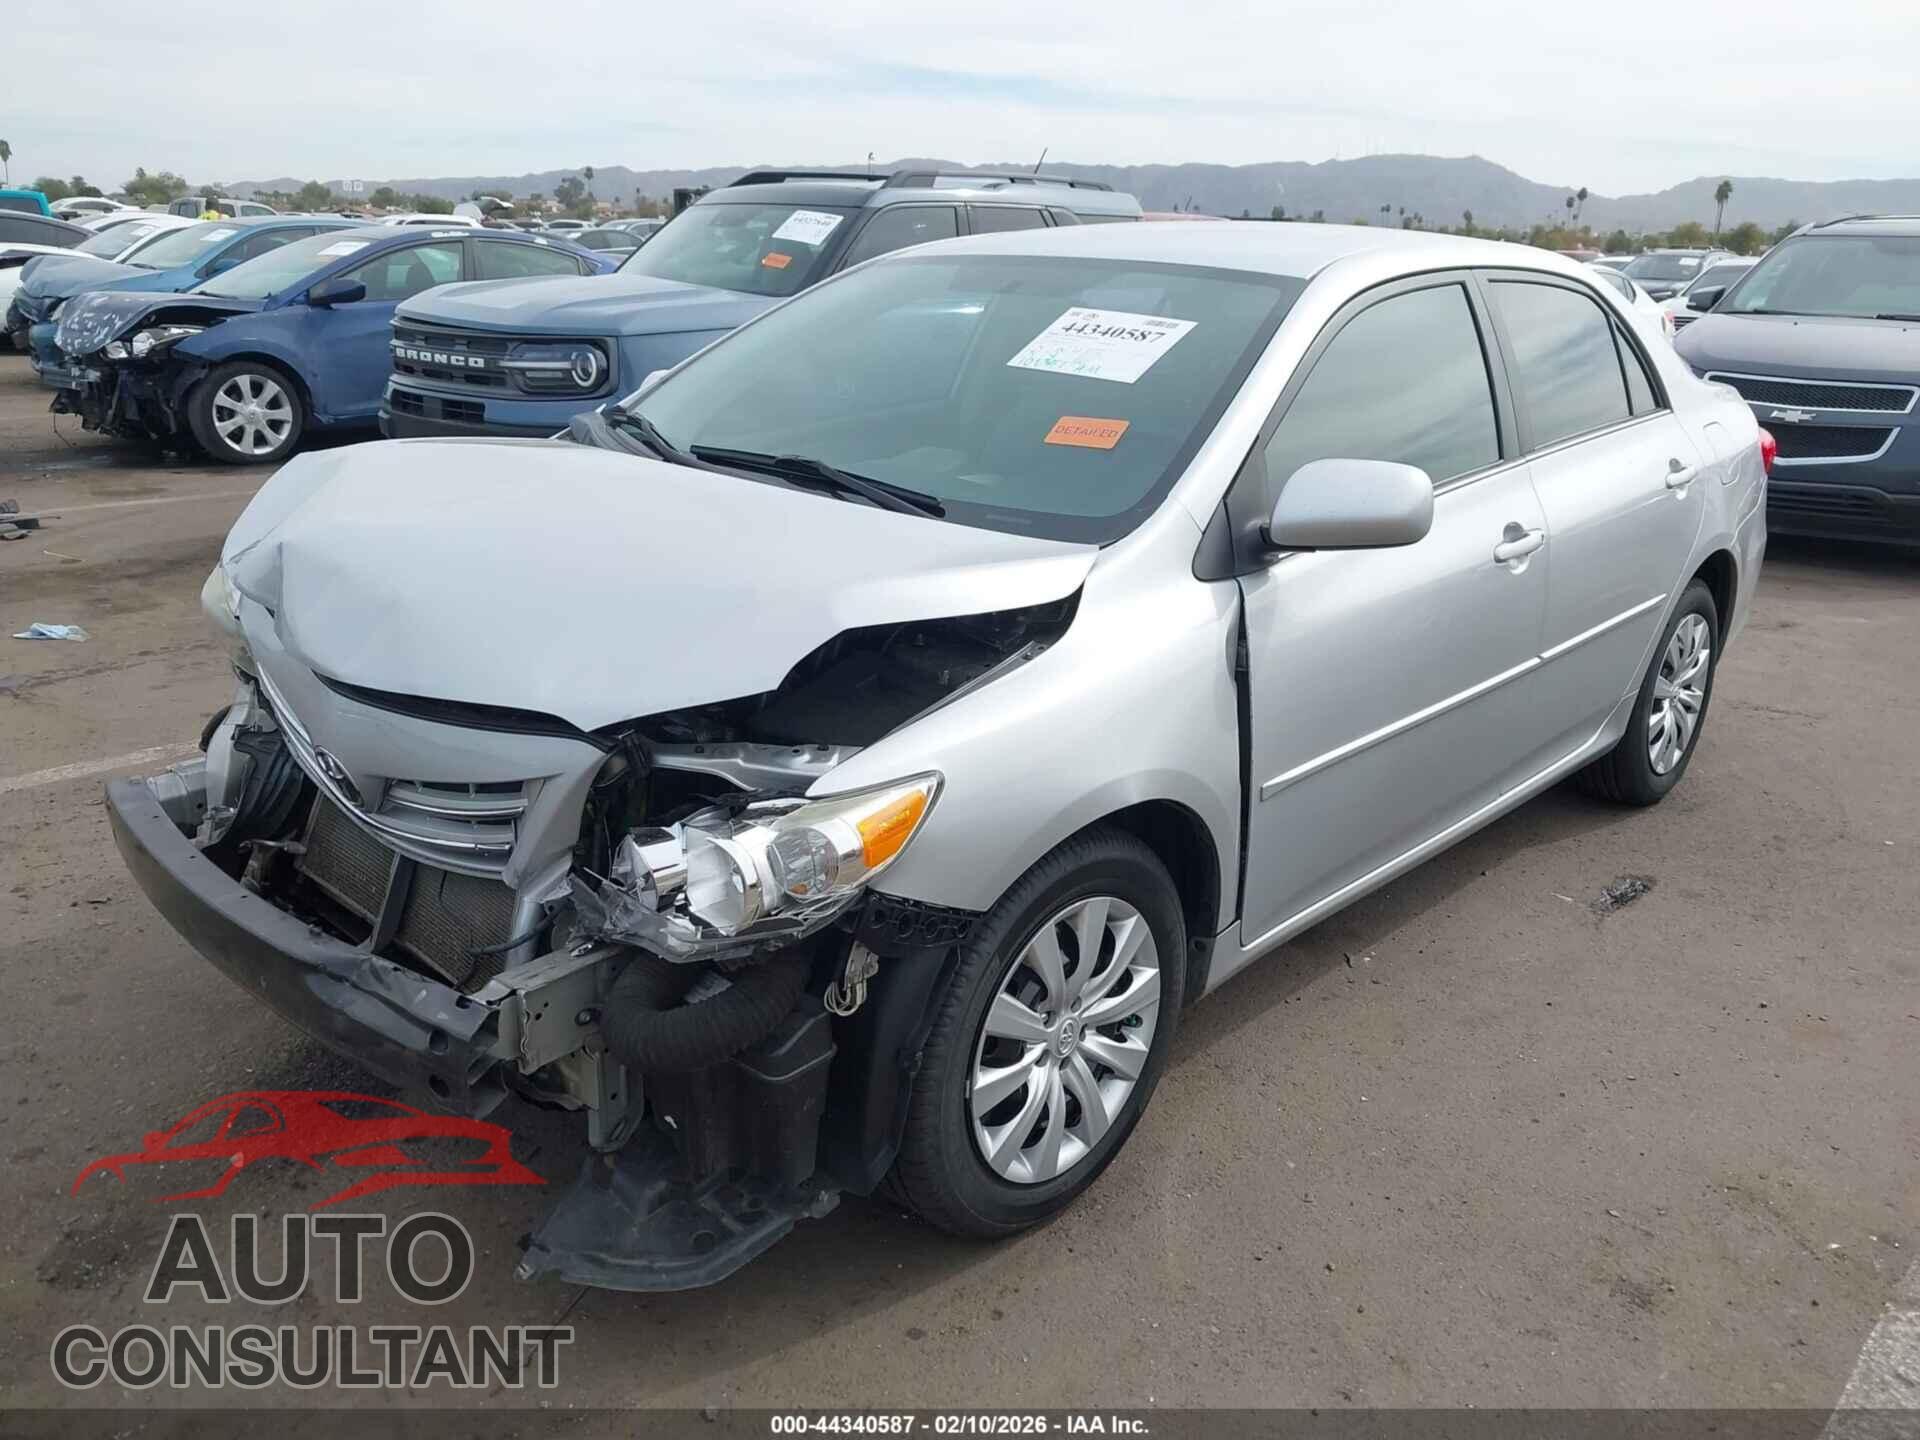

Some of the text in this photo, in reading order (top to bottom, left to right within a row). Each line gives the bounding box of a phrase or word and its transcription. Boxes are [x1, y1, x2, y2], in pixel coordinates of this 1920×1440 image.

[1062, 322, 1165, 343] 44340587
[396, 347, 484, 368] BRONCO
[1055, 425, 1118, 438] DETAILED
